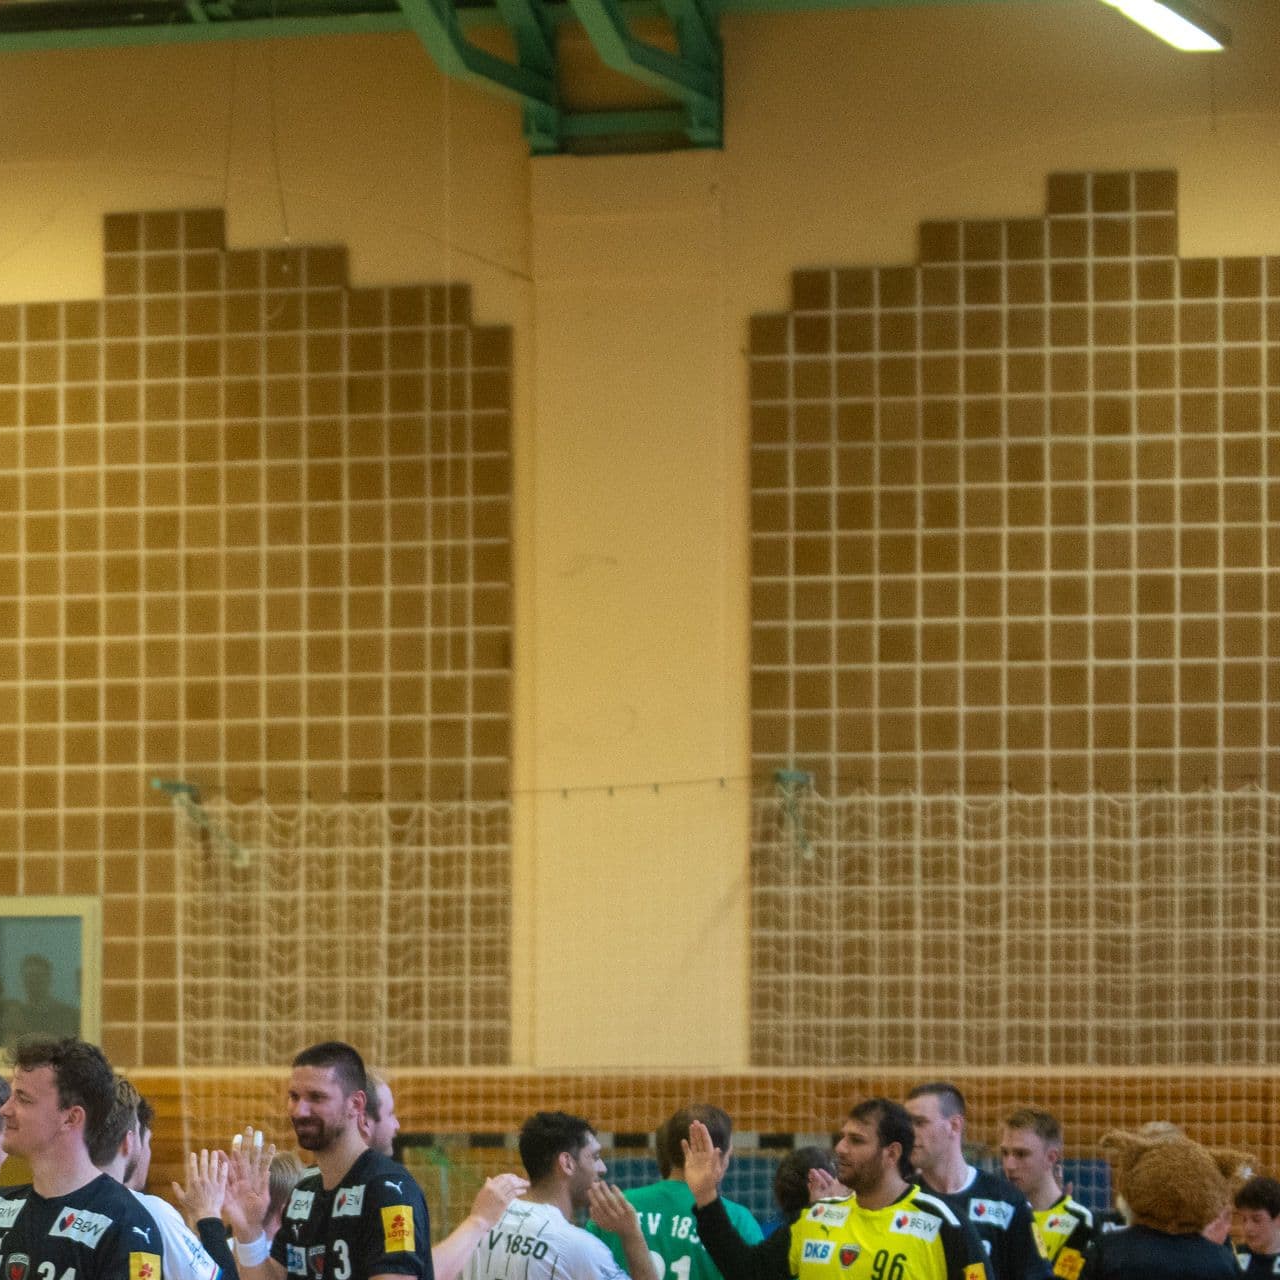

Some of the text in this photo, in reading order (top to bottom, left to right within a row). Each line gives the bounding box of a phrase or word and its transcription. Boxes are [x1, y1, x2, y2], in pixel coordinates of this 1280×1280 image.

[71, 1217, 104, 1236] BEW
[909, 1217, 936, 1232] BEW
[505, 1233, 550, 1260] 1850
[804, 1242, 831, 1259] DKB
[333, 1239, 352, 1280] 3
